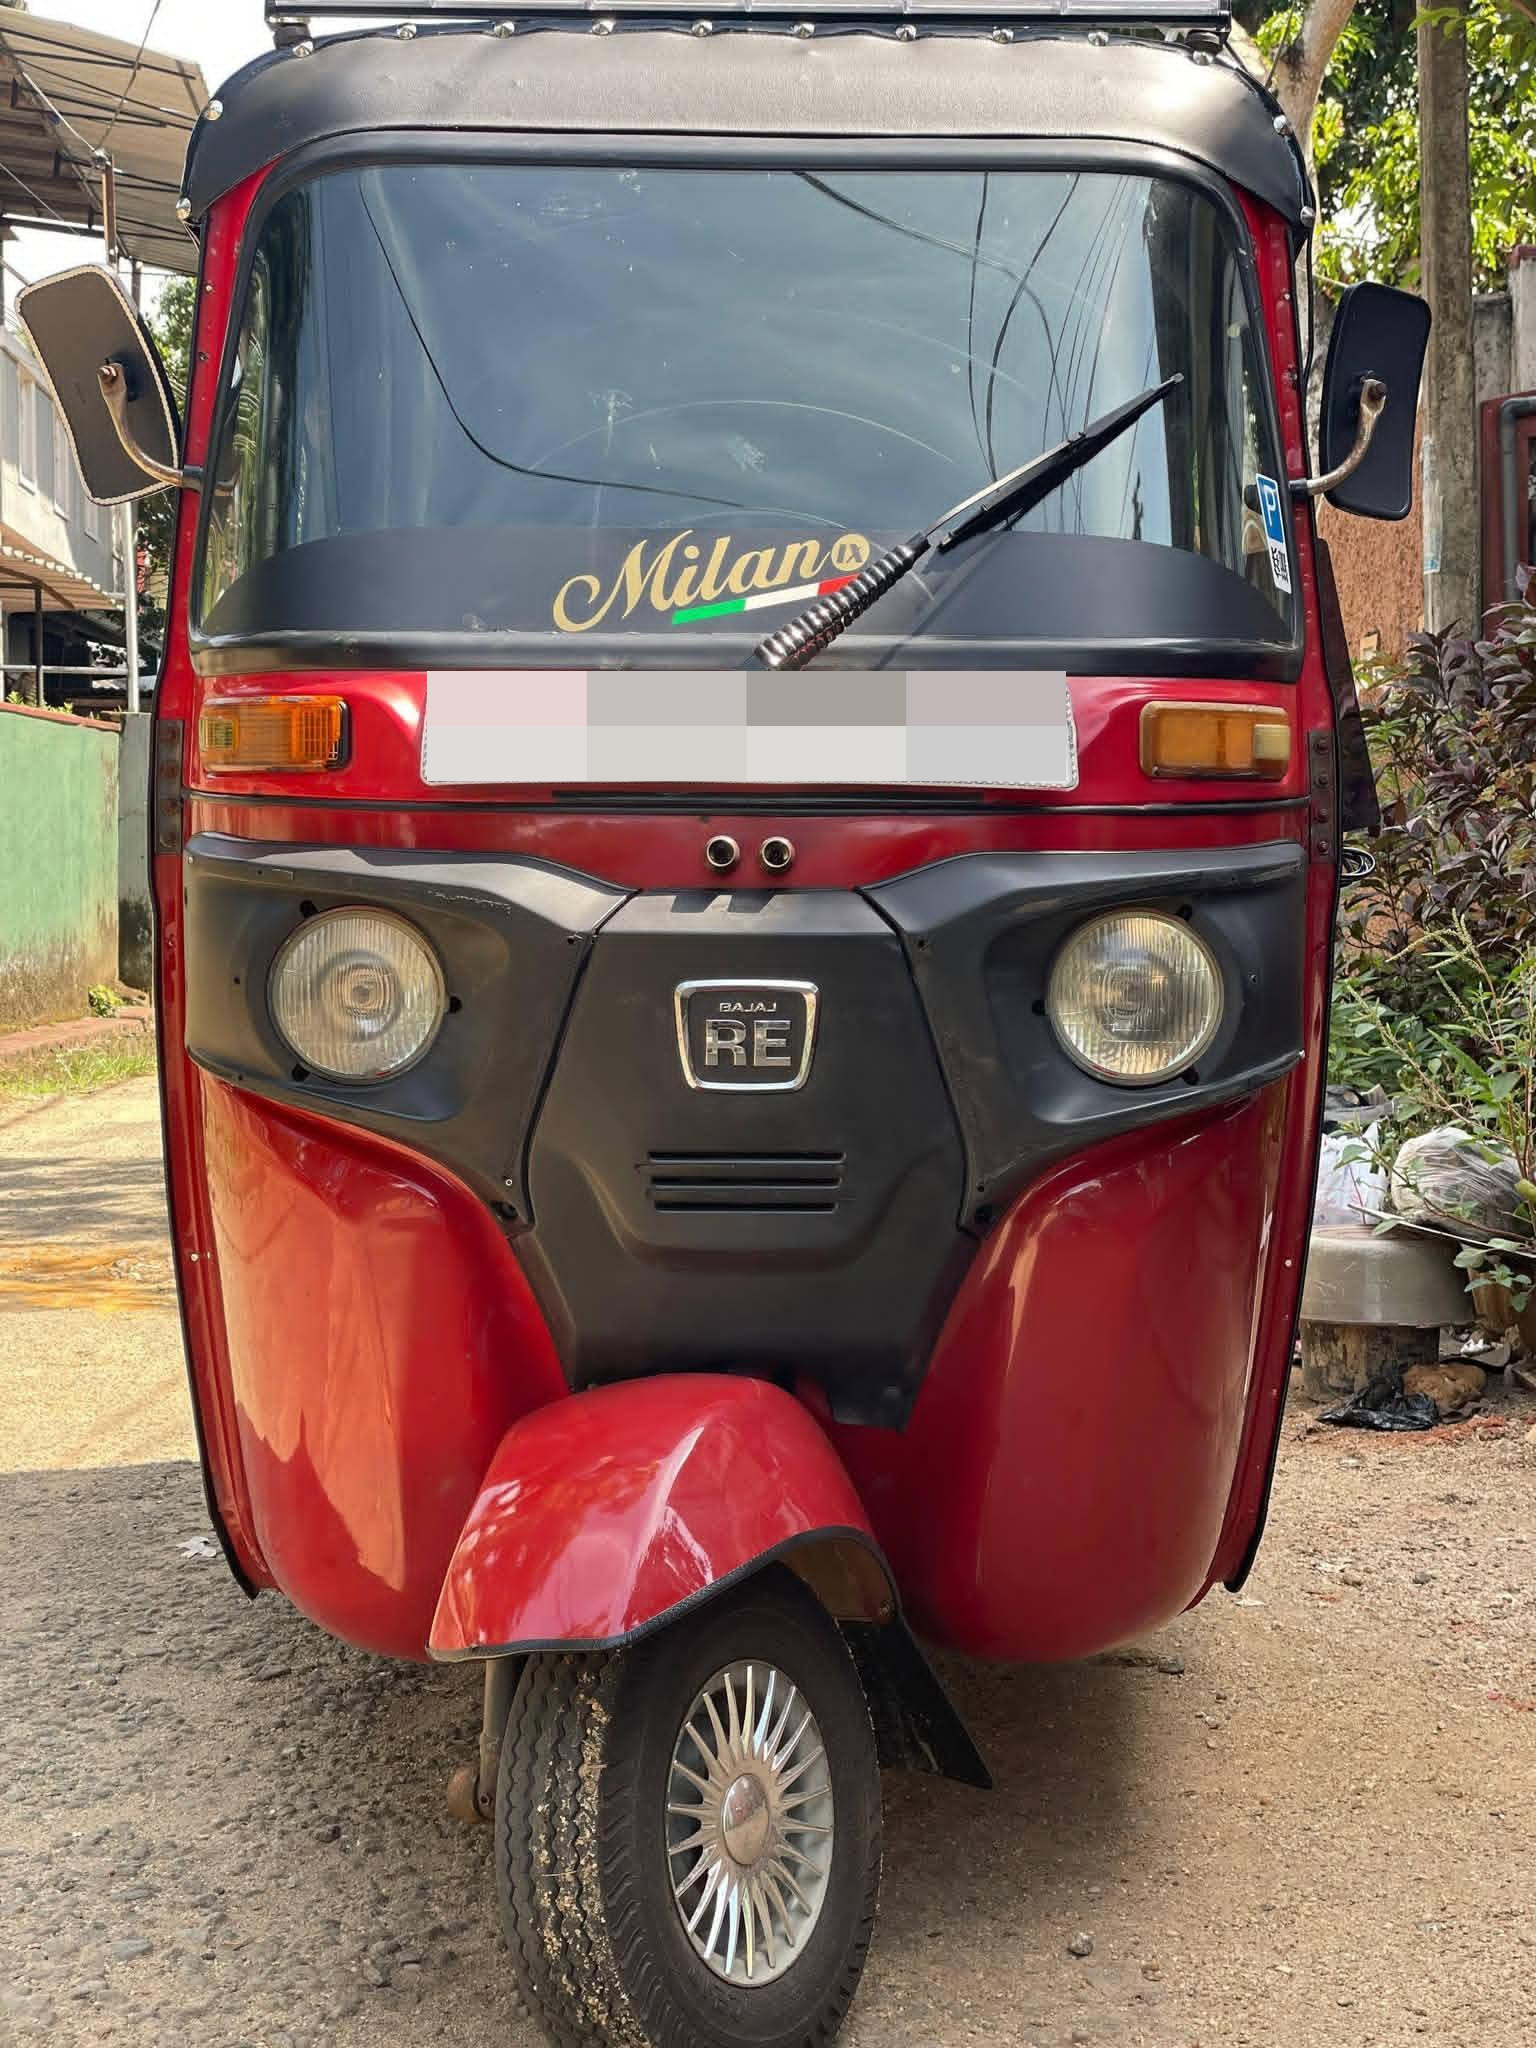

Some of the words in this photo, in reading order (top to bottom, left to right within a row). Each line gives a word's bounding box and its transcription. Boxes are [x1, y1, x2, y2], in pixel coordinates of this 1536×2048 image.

[1263, 484, 1277, 527] P
[719, 1002, 777, 1013] BAJAJ
[705, 1019, 792, 1067] RE
